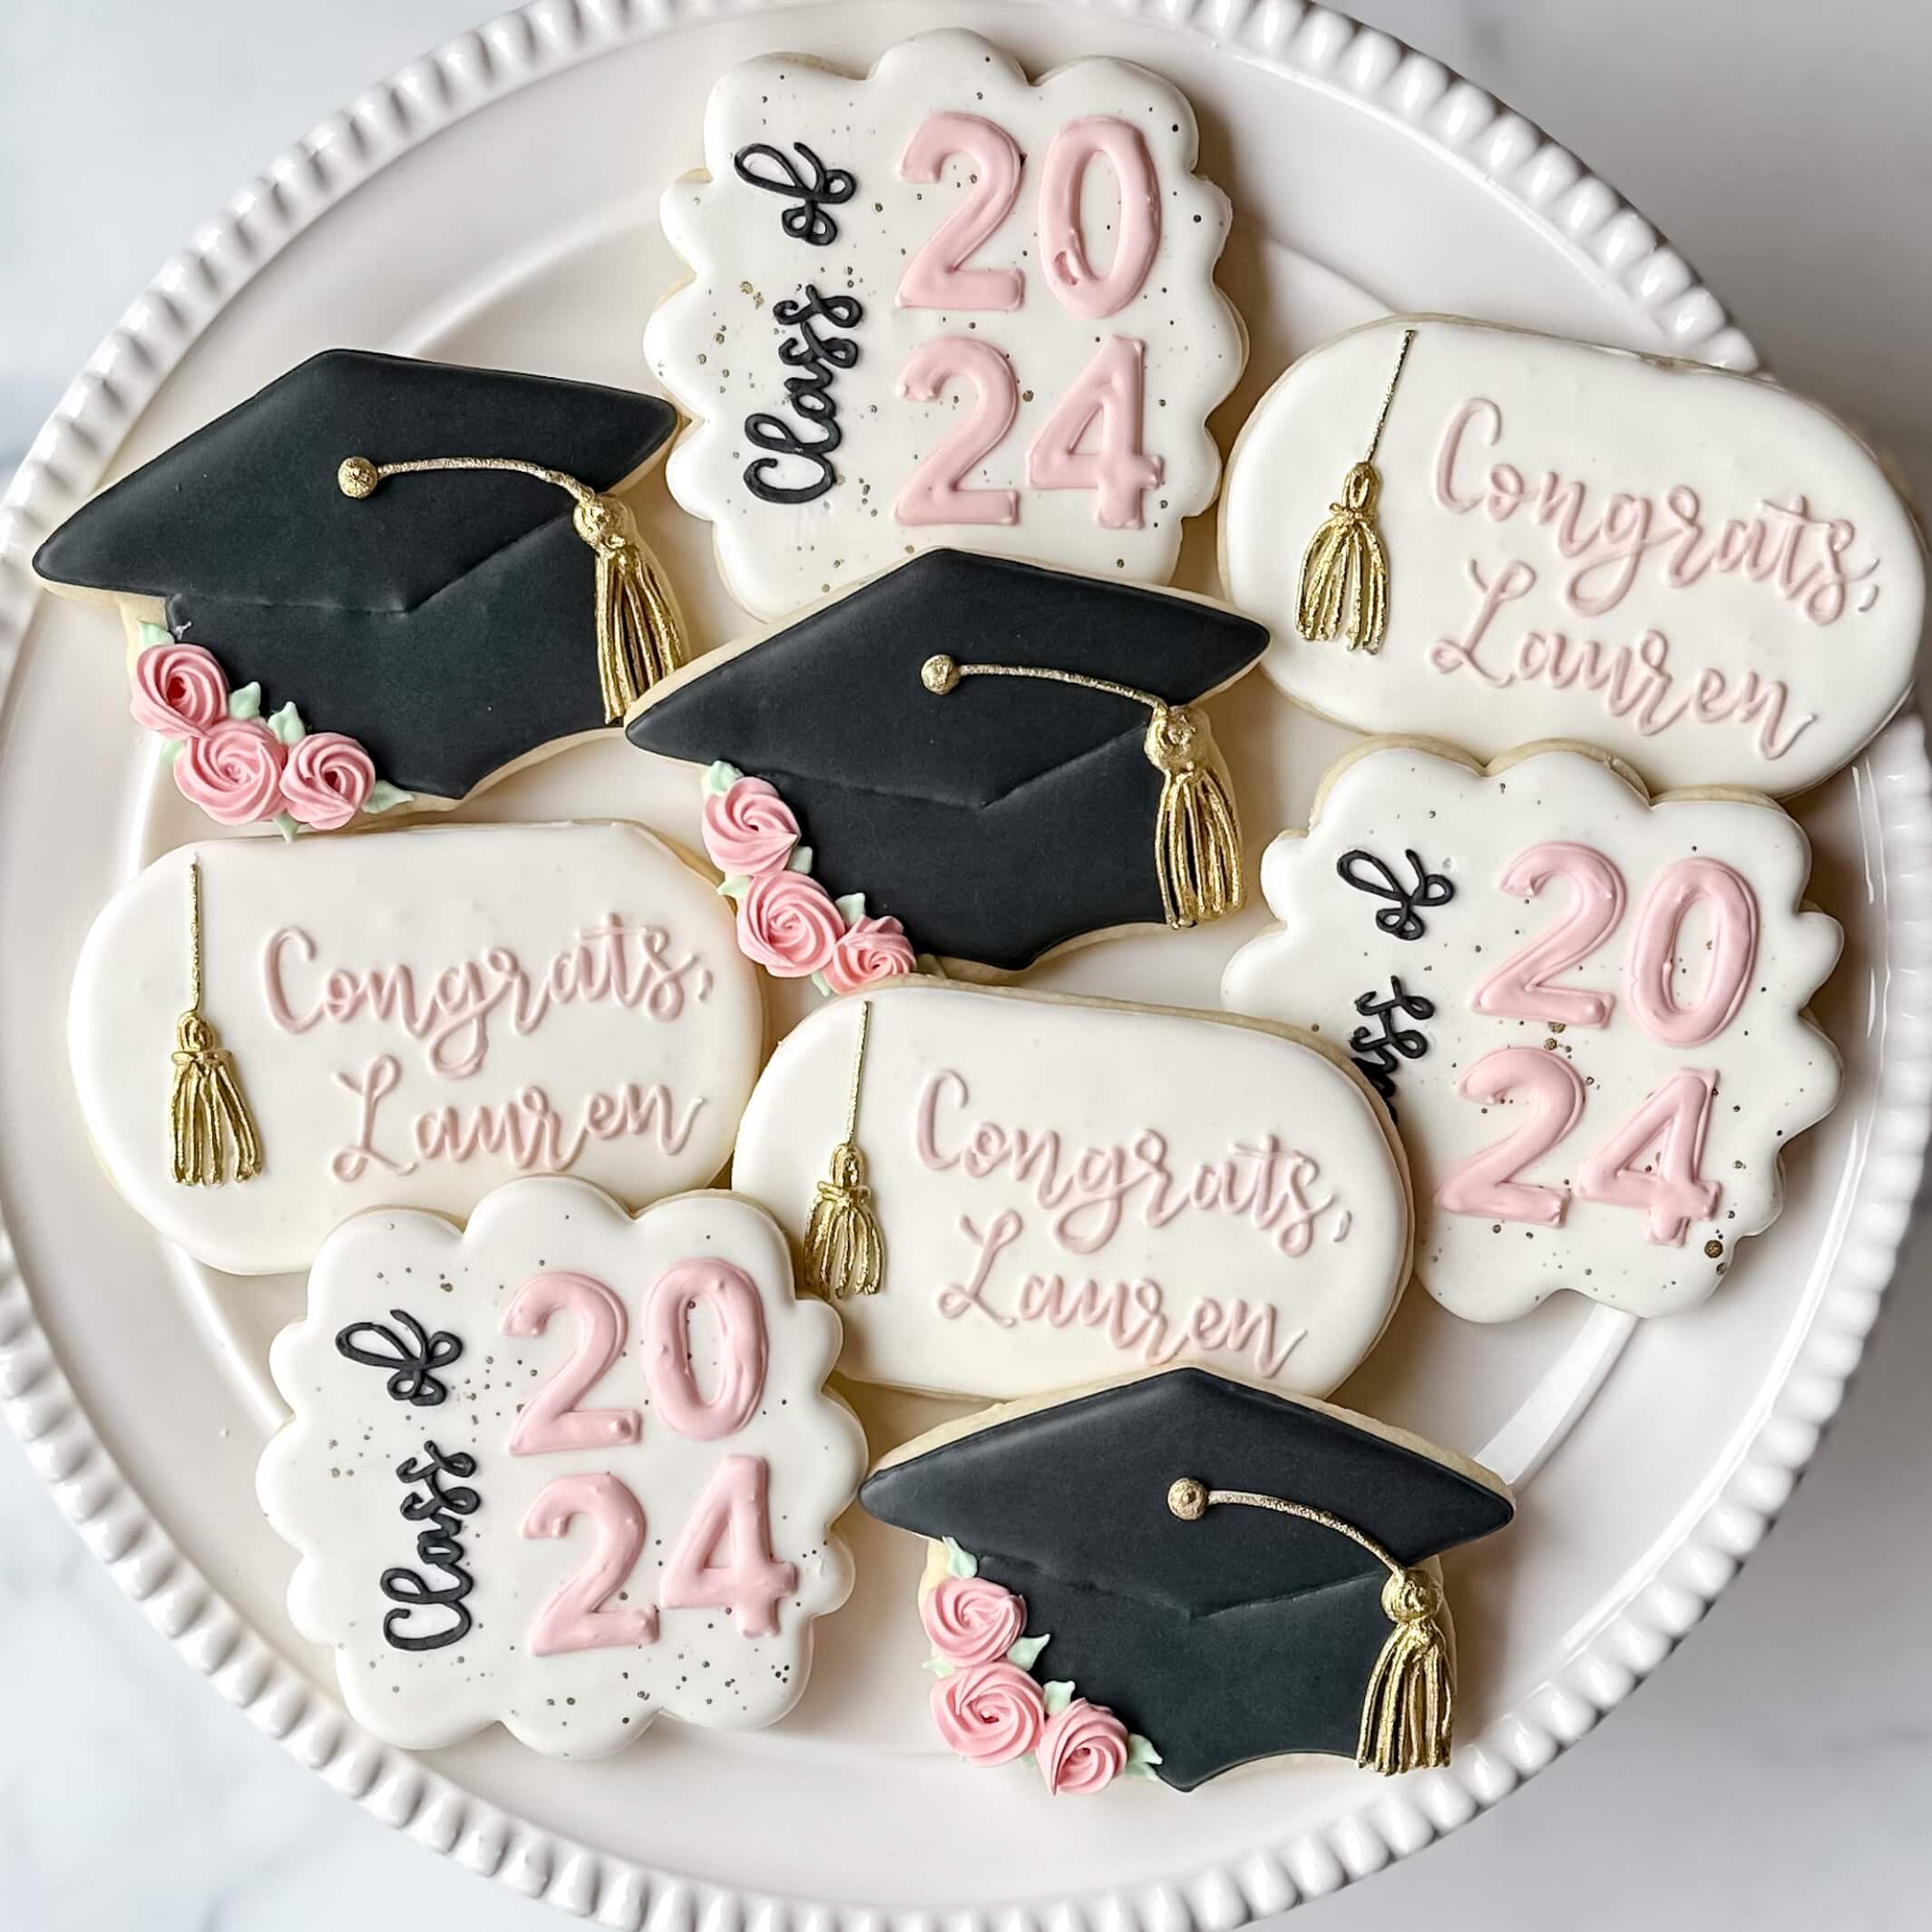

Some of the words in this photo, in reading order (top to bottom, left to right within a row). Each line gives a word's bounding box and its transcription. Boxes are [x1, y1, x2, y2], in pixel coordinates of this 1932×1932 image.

[734, 141, 857, 246] of
[896, 111, 1161, 318] 20
[743, 284, 863, 504] Class
[890, 335, 1164, 530] 24
[1430, 559, 1818, 761] Lauren
[1337, 849, 1454, 941] of
[1471, 842, 1760, 1049] 20
[330, 1054, 707, 1182] Lauren
[1434, 1047, 1722, 1247] 24
[336, 1309, 463, 1406] of
[500, 1257, 769, 1456] 20
[937, 1209, 1308, 1378] Lauren
[379, 1439, 481, 1651] Class
[519, 1455, 797, 1657] 24
